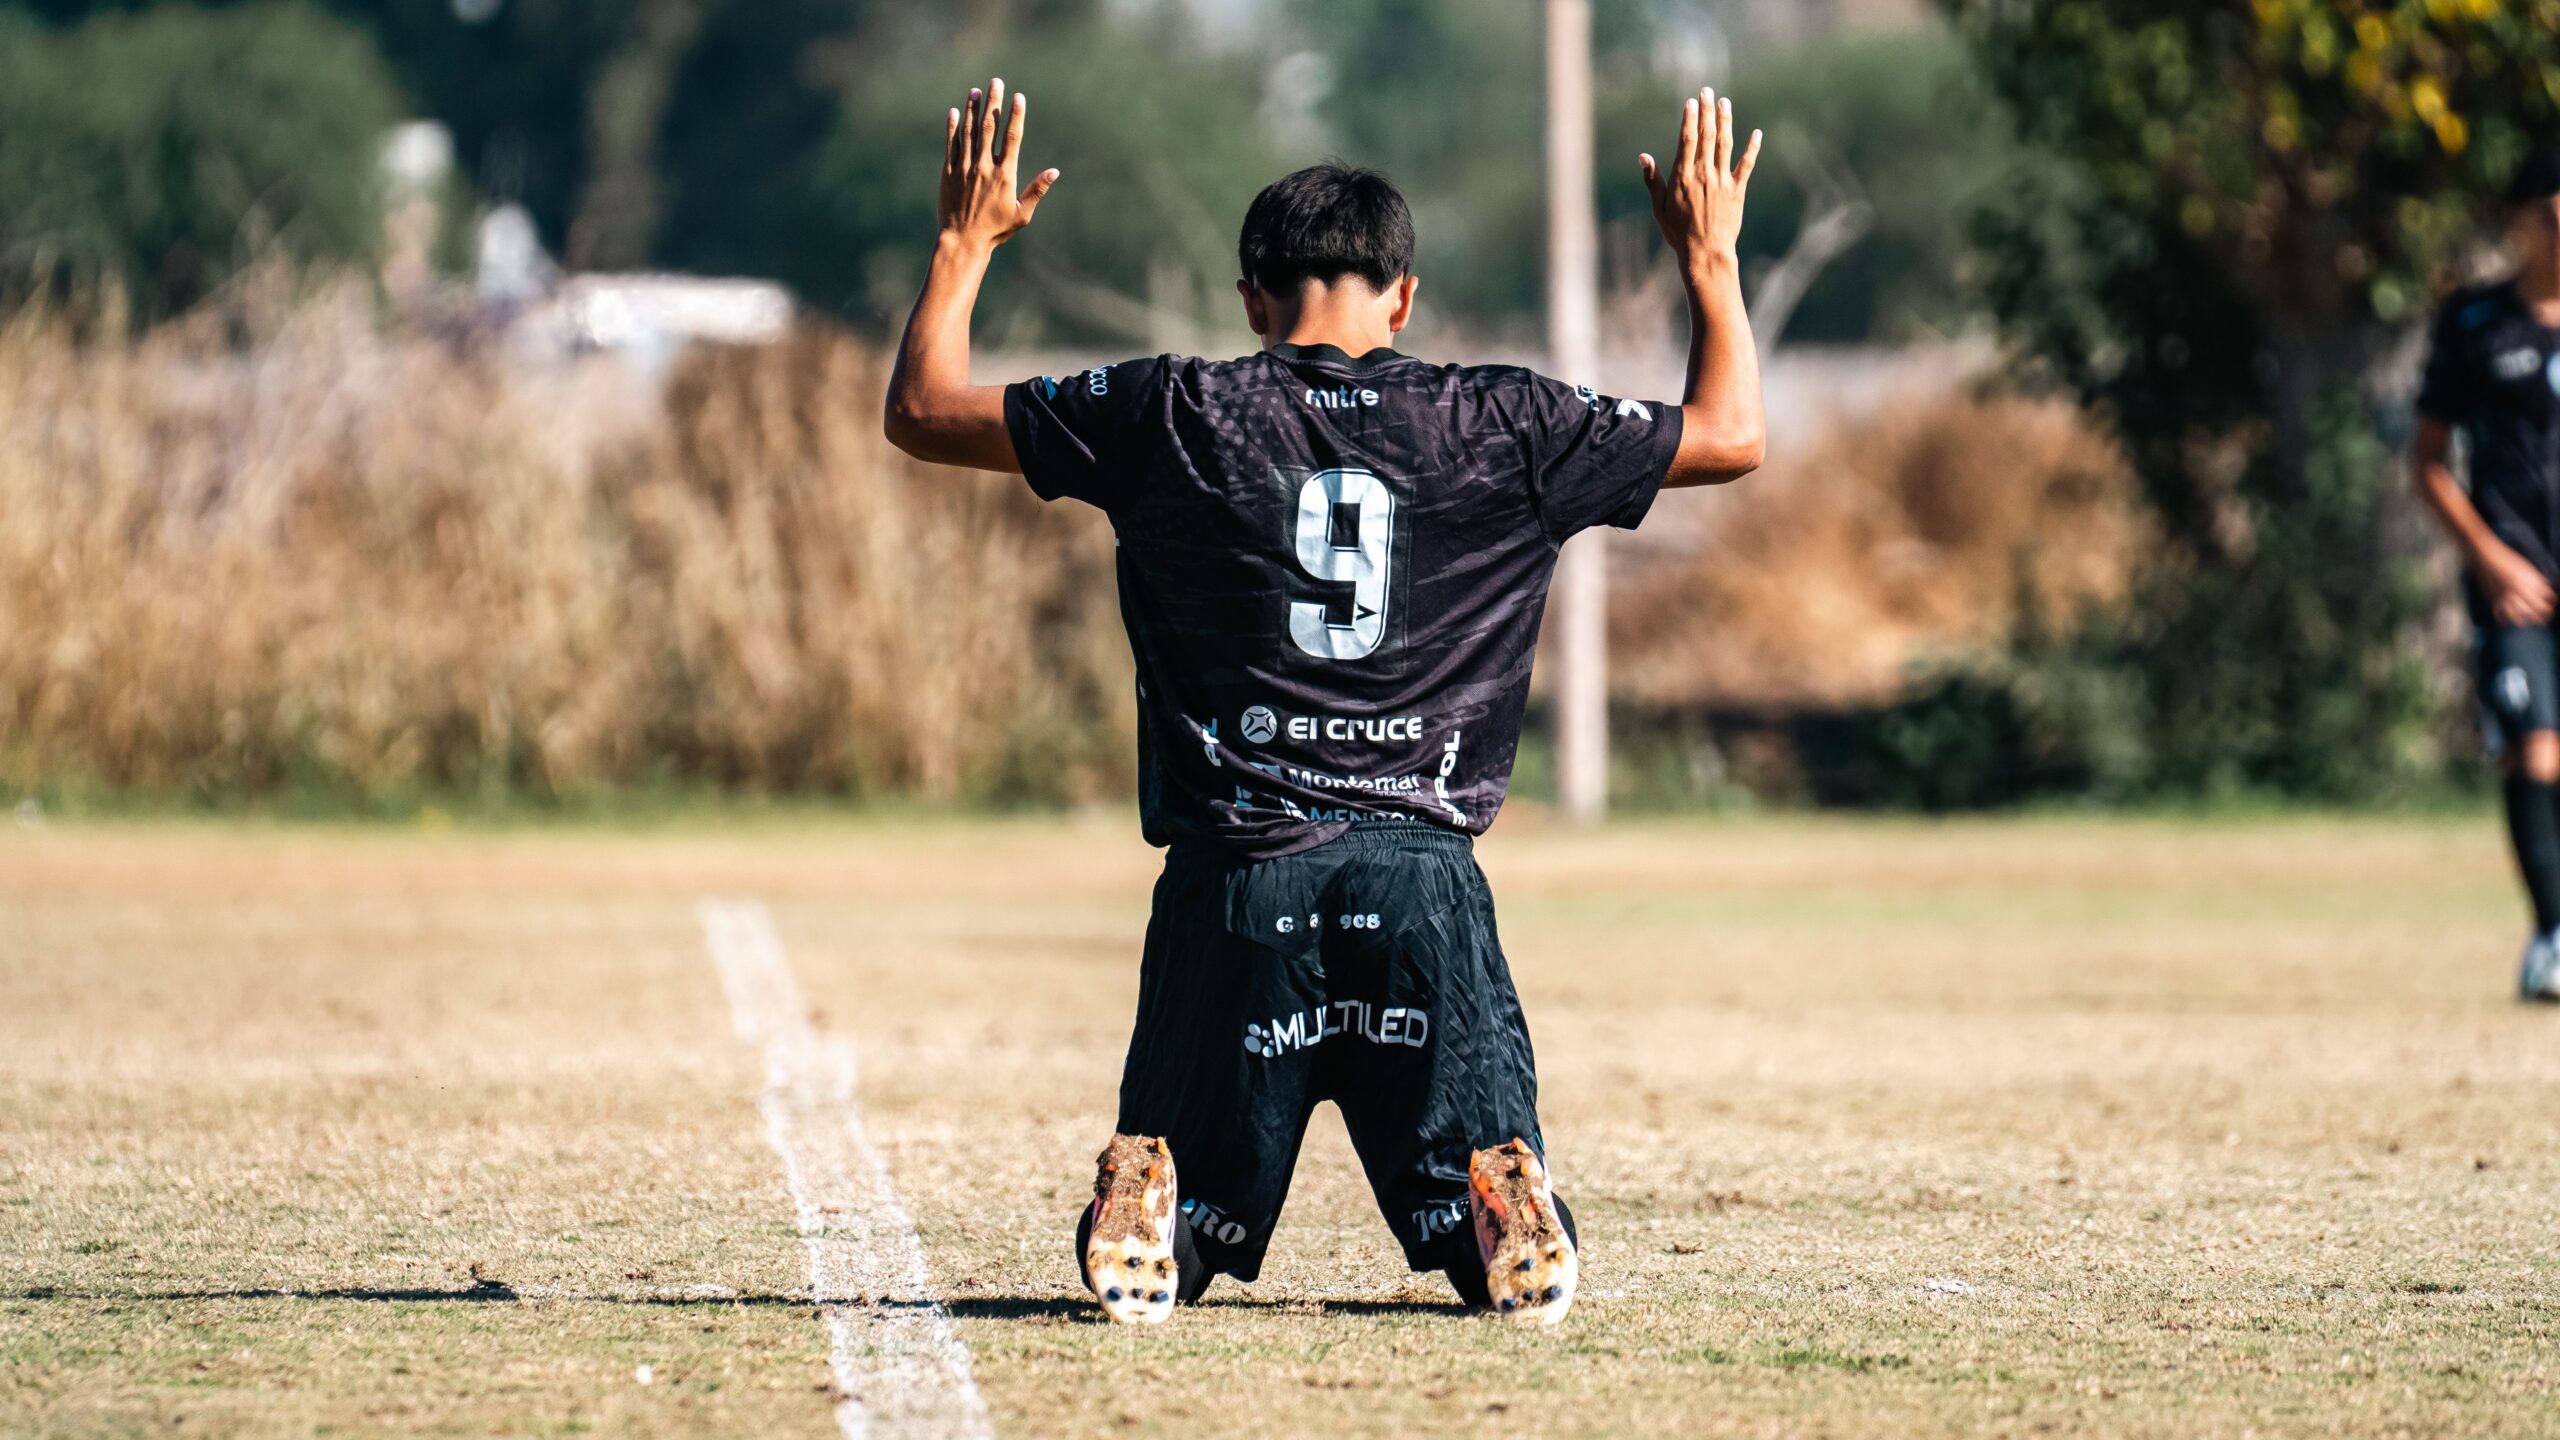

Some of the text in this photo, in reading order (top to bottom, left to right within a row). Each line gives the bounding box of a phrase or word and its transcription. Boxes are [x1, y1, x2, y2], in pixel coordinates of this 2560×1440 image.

[1305, 385, 1379, 408] mitre
[1289, 468, 1394, 660] 9
[1272, 1000, 1428, 1056] MULTILED
